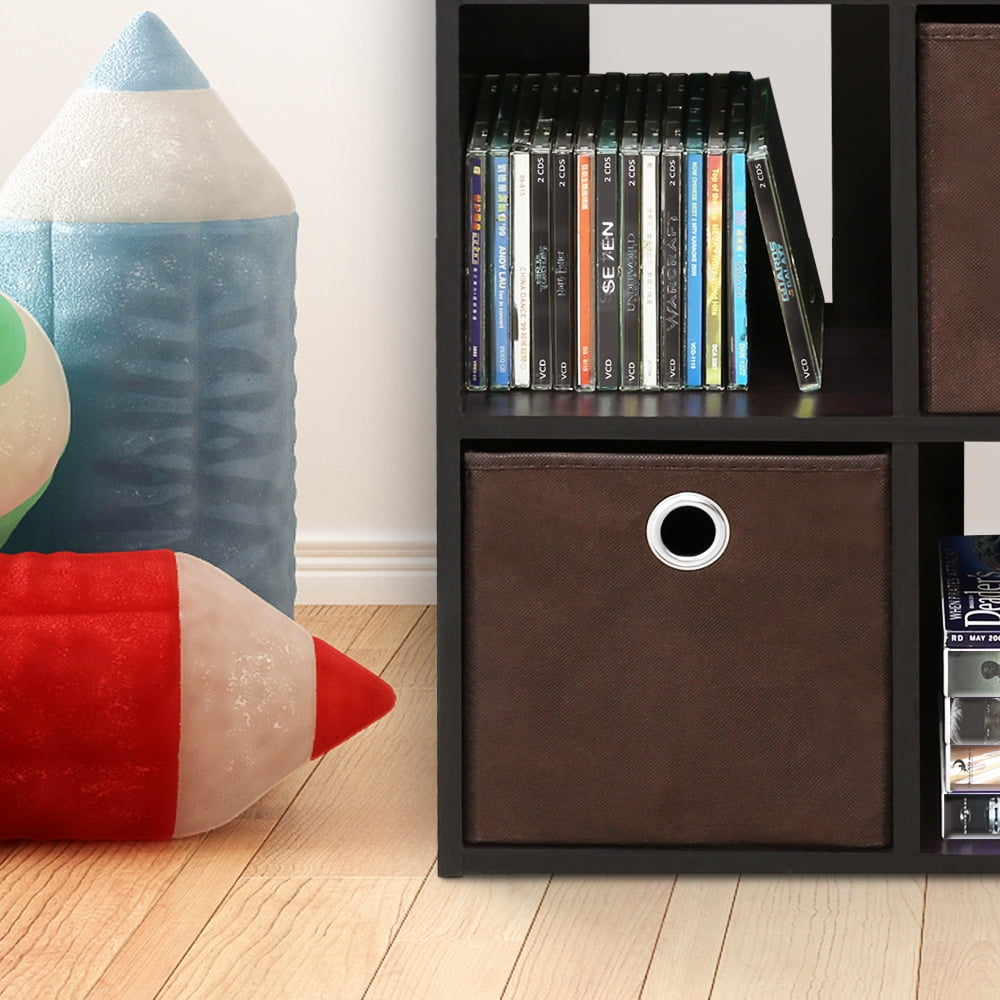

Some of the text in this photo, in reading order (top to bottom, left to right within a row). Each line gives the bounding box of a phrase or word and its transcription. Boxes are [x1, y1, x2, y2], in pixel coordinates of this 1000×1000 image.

[537, 157, 545, 175] CDS
[558, 158, 566, 188] 2 CDS
[604, 156, 612, 175] CDS
[628, 159, 636, 178] CDS
[711, 168, 720, 182] Top
[754, 164, 766, 189] 2 CDS
[712, 184, 720, 192] of
[712, 192, 720, 204] the
[498, 246, 506, 270] ANDY
[778, 243, 794, 288] GALAXY
[498, 271, 506, 289] LAU
[627, 233, 636, 312] UNDERWORLD
[666, 211, 679, 332] WARCRAFT
[769, 240, 790, 302] GUARDS
[538, 359, 547, 380] VCD
[560, 362, 568, 380] VCD
[604, 358, 612, 380] VCD
[628, 362, 636, 382] VCD
[800, 359, 810, 378] VCD
[948, 600, 962, 621] WHEN
[951, 634, 964, 642] RD
[969, 634, 986, 642] MAY
